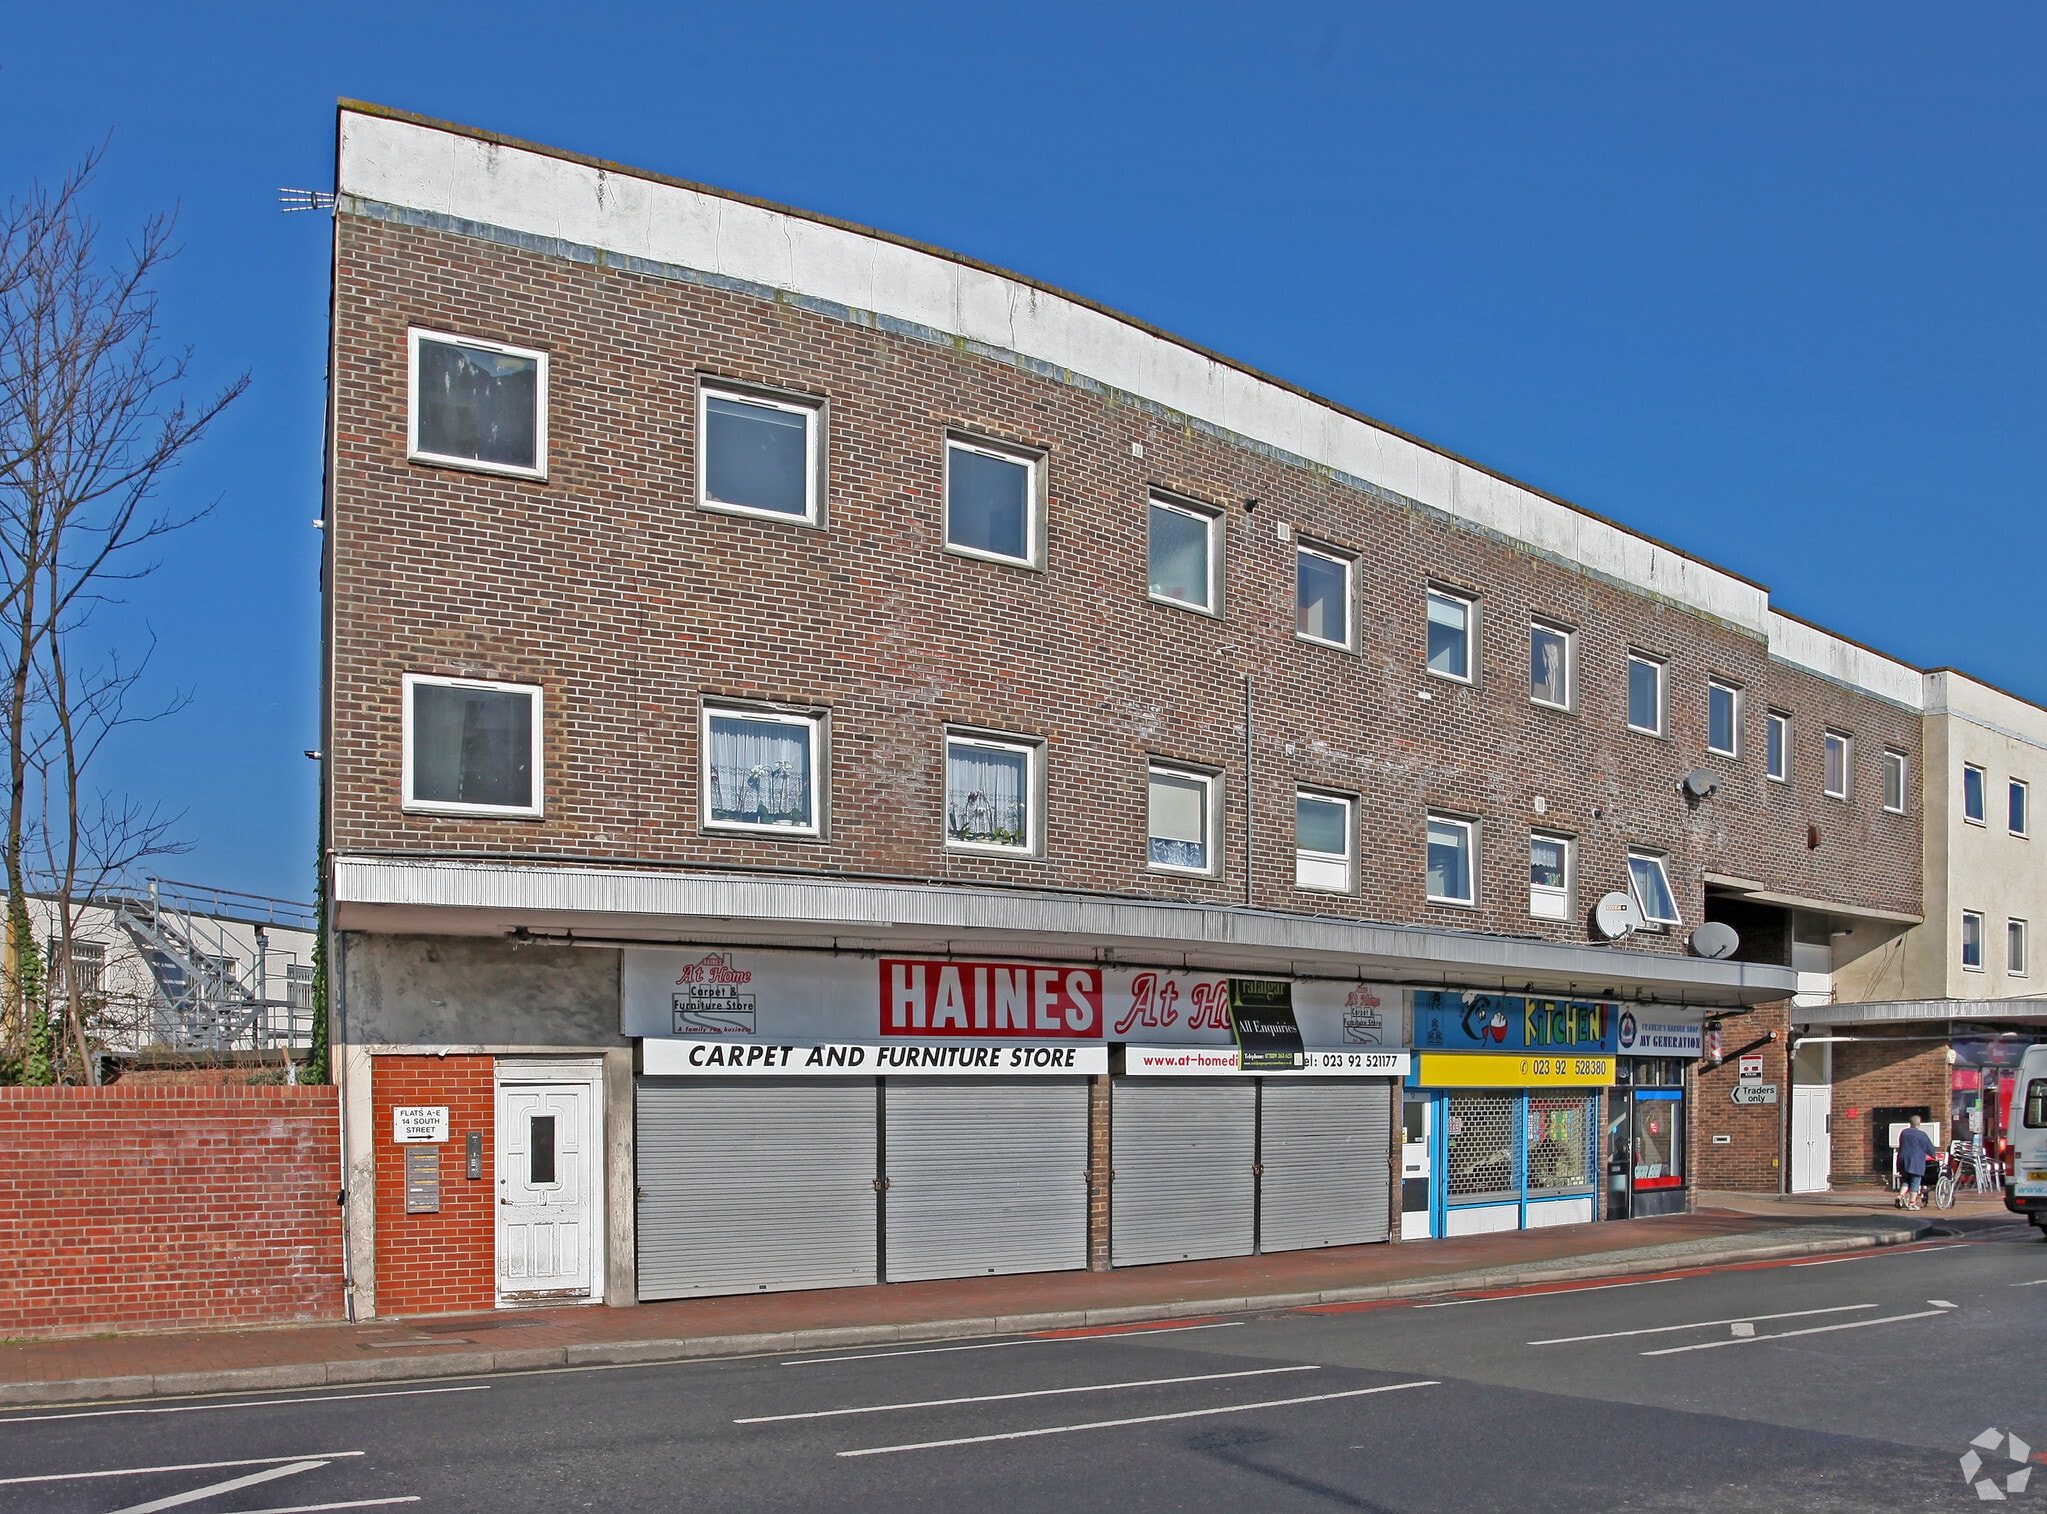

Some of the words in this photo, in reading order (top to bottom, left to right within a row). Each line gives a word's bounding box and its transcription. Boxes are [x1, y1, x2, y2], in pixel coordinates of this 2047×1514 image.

[676, 964, 704, 985] At
[708, 965, 752, 984] Home
[691, 986, 726, 998] Carpet
[730, 986, 738, 997] &
[891, 964, 1094, 1032] HAINES
[674, 1000, 722, 1011] Furniture
[726, 1000, 754, 1011] Store
[1114, 972, 1179, 1035] At
[1187, 980, 1233, 1030] Ho
[1239, 1020, 1252, 1033] All
[1253, 1021, 1298, 1037] Enquiries
[1640, 1035, 1651, 1047] MY
[1653, 1035, 1700, 1049] GENERATION
[689, 1045, 793, 1067] CARPET
[805, 1046, 865, 1067] AND
[876, 1047, 1001, 1067] FURNITURE
[1009, 1048, 1076, 1067] STORE
[1143, 1054, 1238, 1067] www.at-homedi
[1304, 1053, 1317, 1067] el:
[1322, 1054, 1343, 1067] 023
[1348, 1055, 1361, 1068] 92
[1366, 1055, 1397, 1068] 521177
[1533, 1060, 1550, 1075] 023
[1555, 1061, 1566, 1075] 92
[1575, 1061, 1606, 1075] 528380
[1743, 1087, 1775, 1095] Traders
[1748, 1095, 1765, 1104] only
[2017, 1186, 2047, 1194] www.
